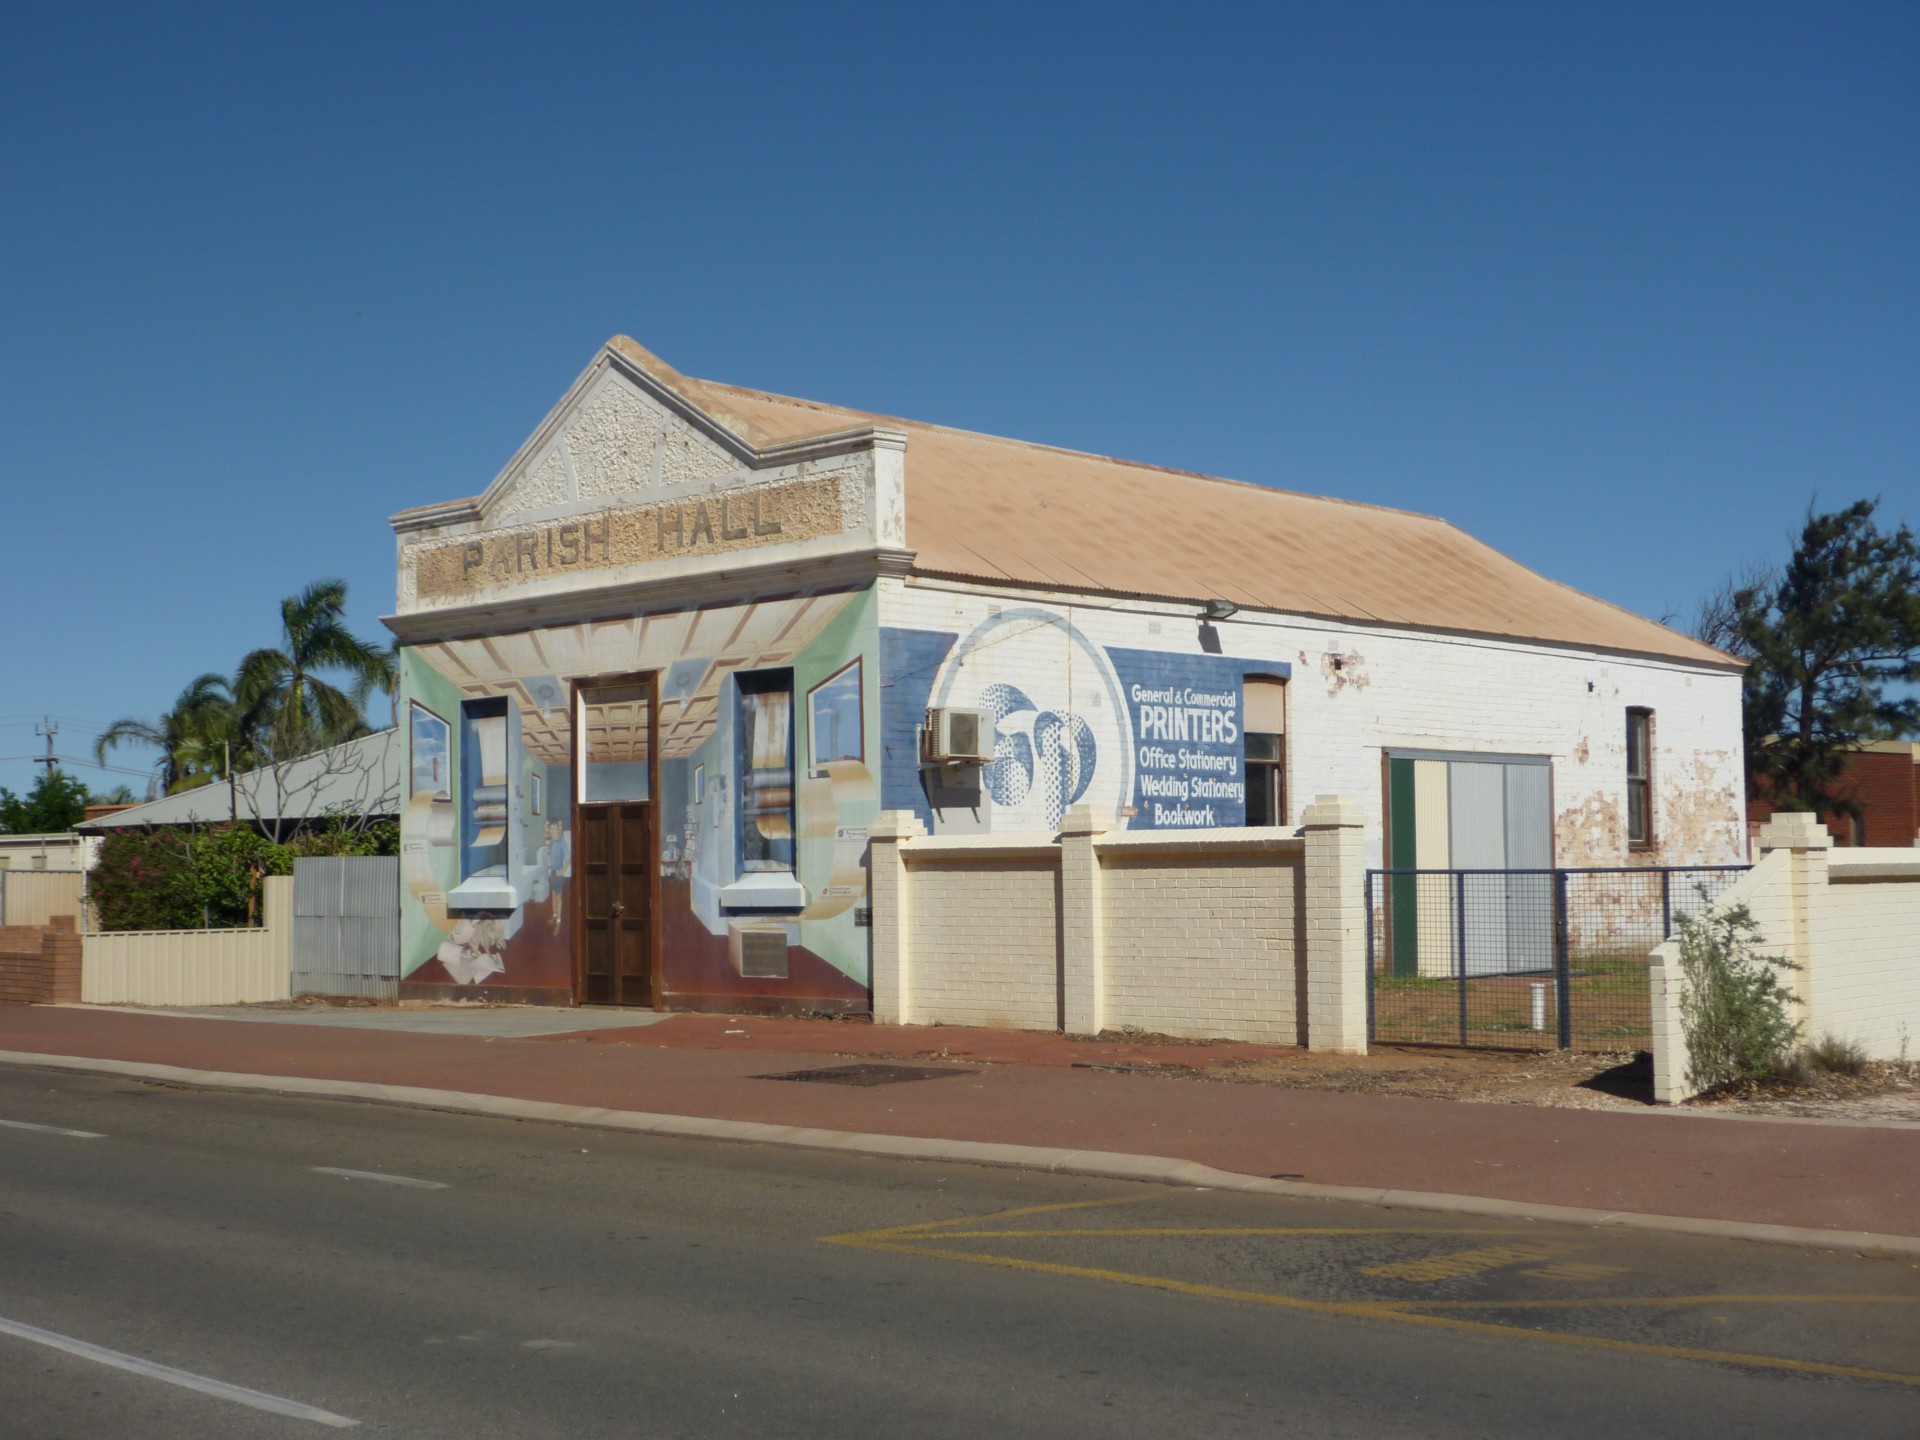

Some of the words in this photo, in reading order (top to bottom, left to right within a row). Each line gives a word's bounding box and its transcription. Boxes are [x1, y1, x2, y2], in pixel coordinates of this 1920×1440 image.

[461, 515, 610, 581] PARISH
[657, 495, 782, 552] HALL
[1131, 684, 1173, 703] General
[1174, 691, 1183, 704] &
[1184, 687, 1236, 708] Commercial
[1140, 704, 1238, 744] PRINTERS
[1139, 746, 1176, 769] Office
[1179, 748, 1237, 775] Stationery
[1140, 774, 1189, 802] Wedding
[1191, 776, 1245, 804] Stationery
[1155, 802, 1215, 826] Bookwork
